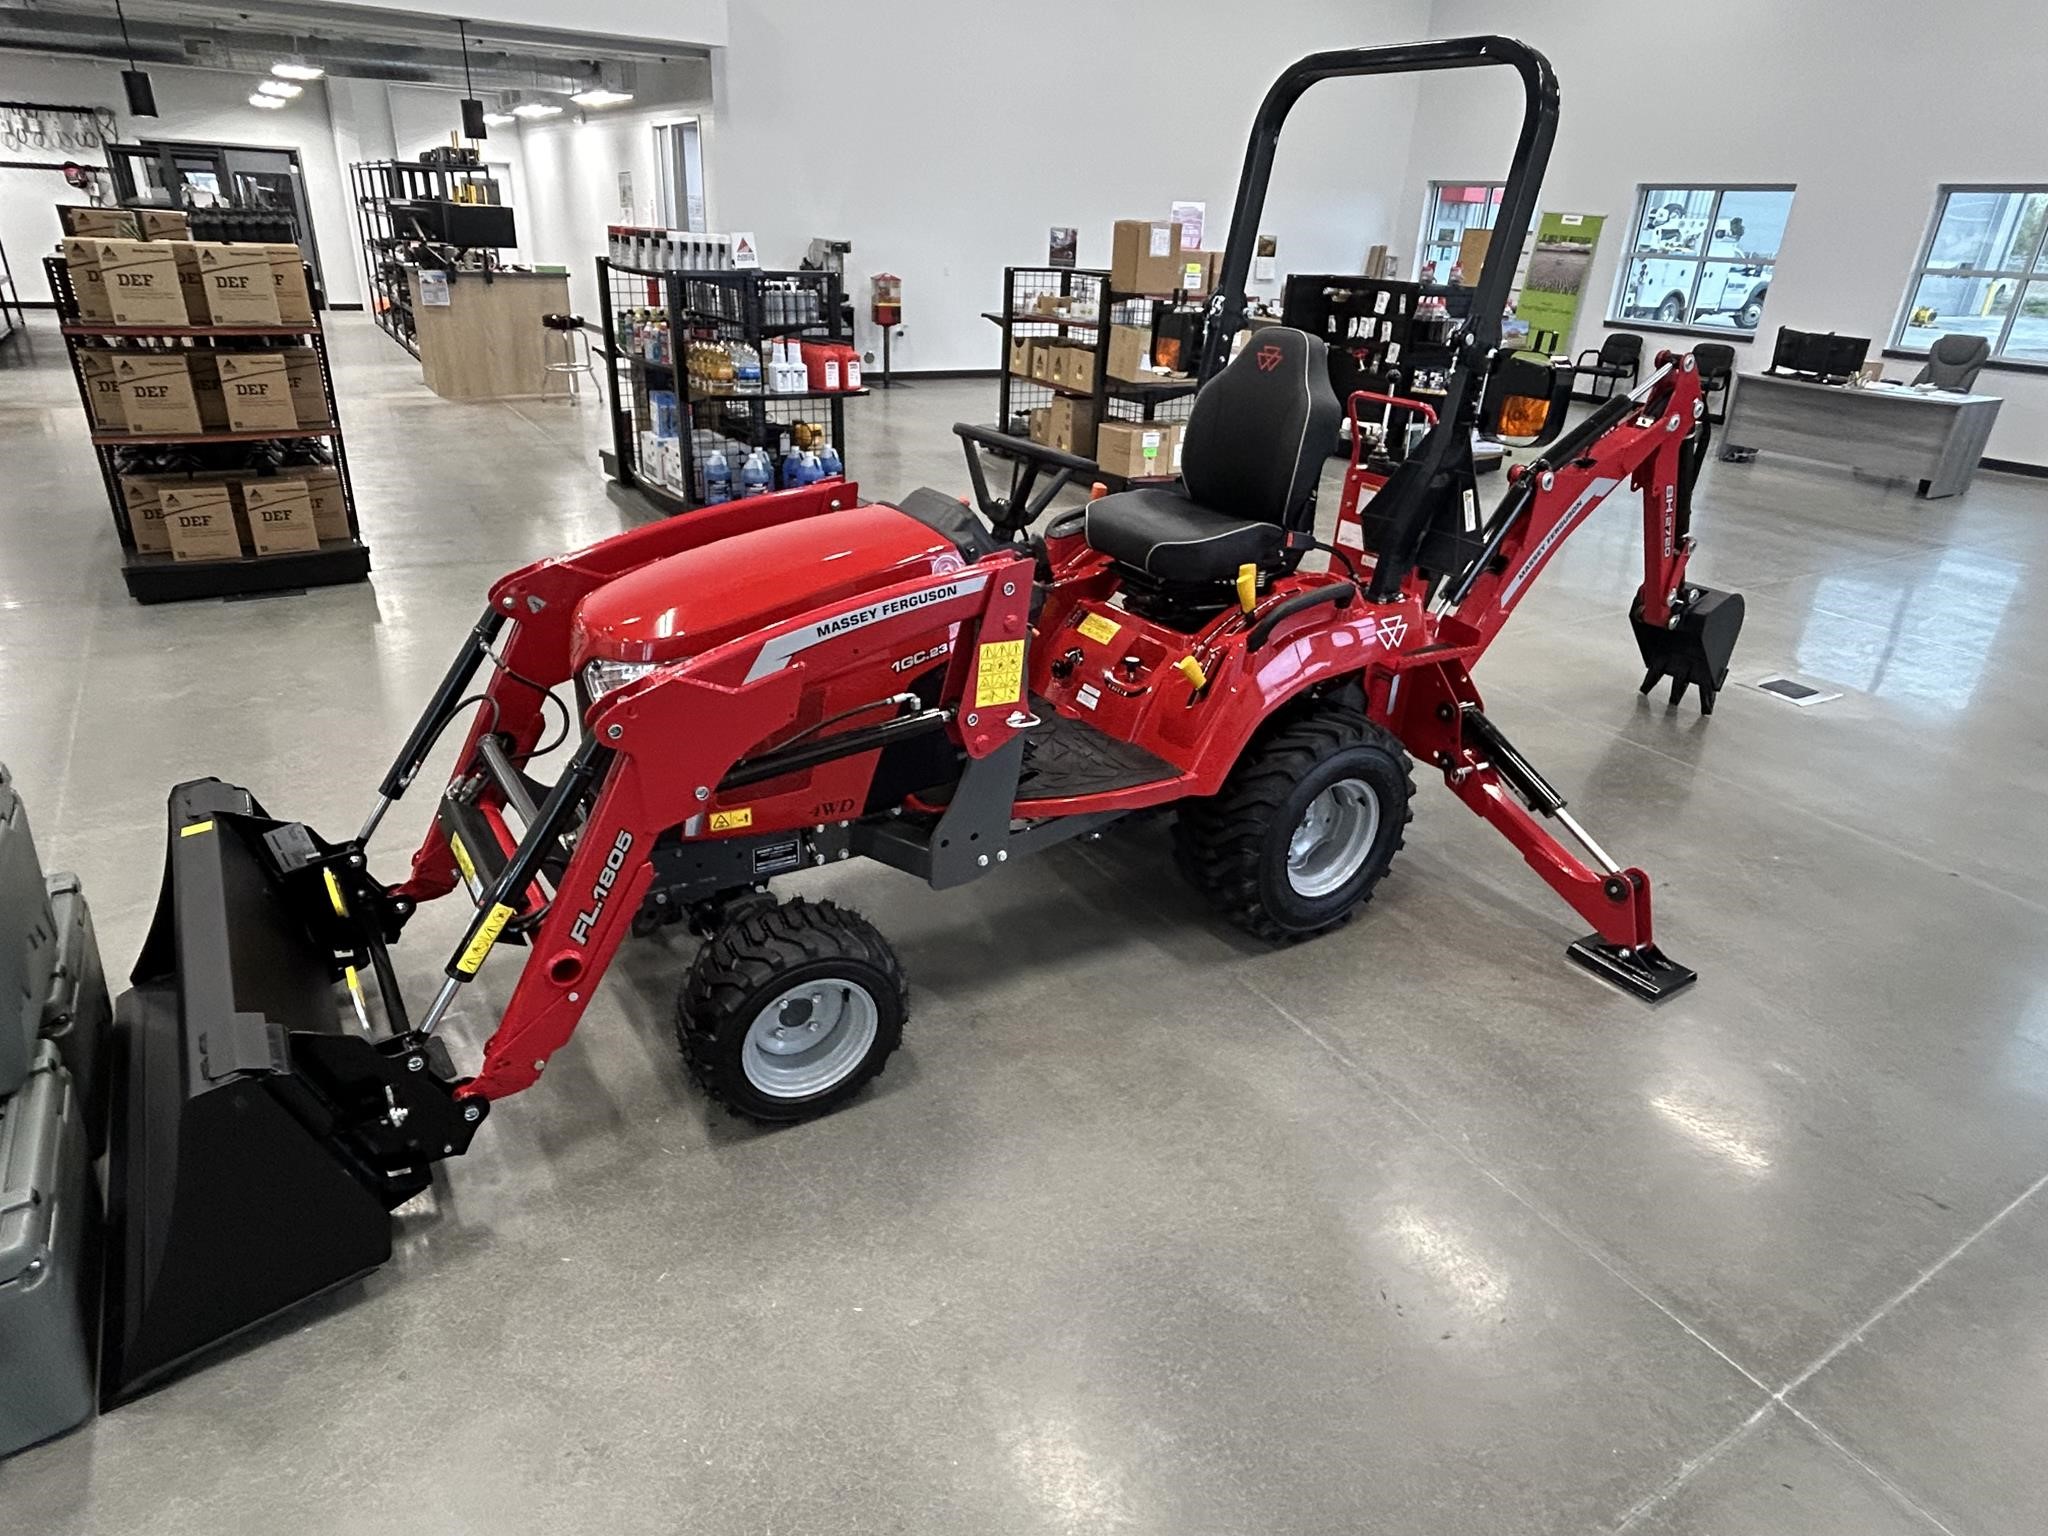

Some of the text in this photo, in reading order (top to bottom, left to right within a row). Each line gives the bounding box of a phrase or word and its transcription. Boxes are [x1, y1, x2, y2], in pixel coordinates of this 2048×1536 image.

[116, 273, 154, 287] DEF
[178, 272, 201, 285] DE
[214, 275, 249, 289] DEF
[98, 380, 120, 393] DE
[133, 385, 169, 398] DEF
[235, 383, 269, 396] DEF
[142, 508, 164, 520] DE
[178, 514, 213, 528] DEF
[260, 509, 293, 522] DEF
[816, 585, 958, 638] MASSEY FERGUSON
[891, 643, 949, 673] 1GC.23
[808, 798, 855, 817] 4WD
[570, 829, 633, 946] FL.1805
